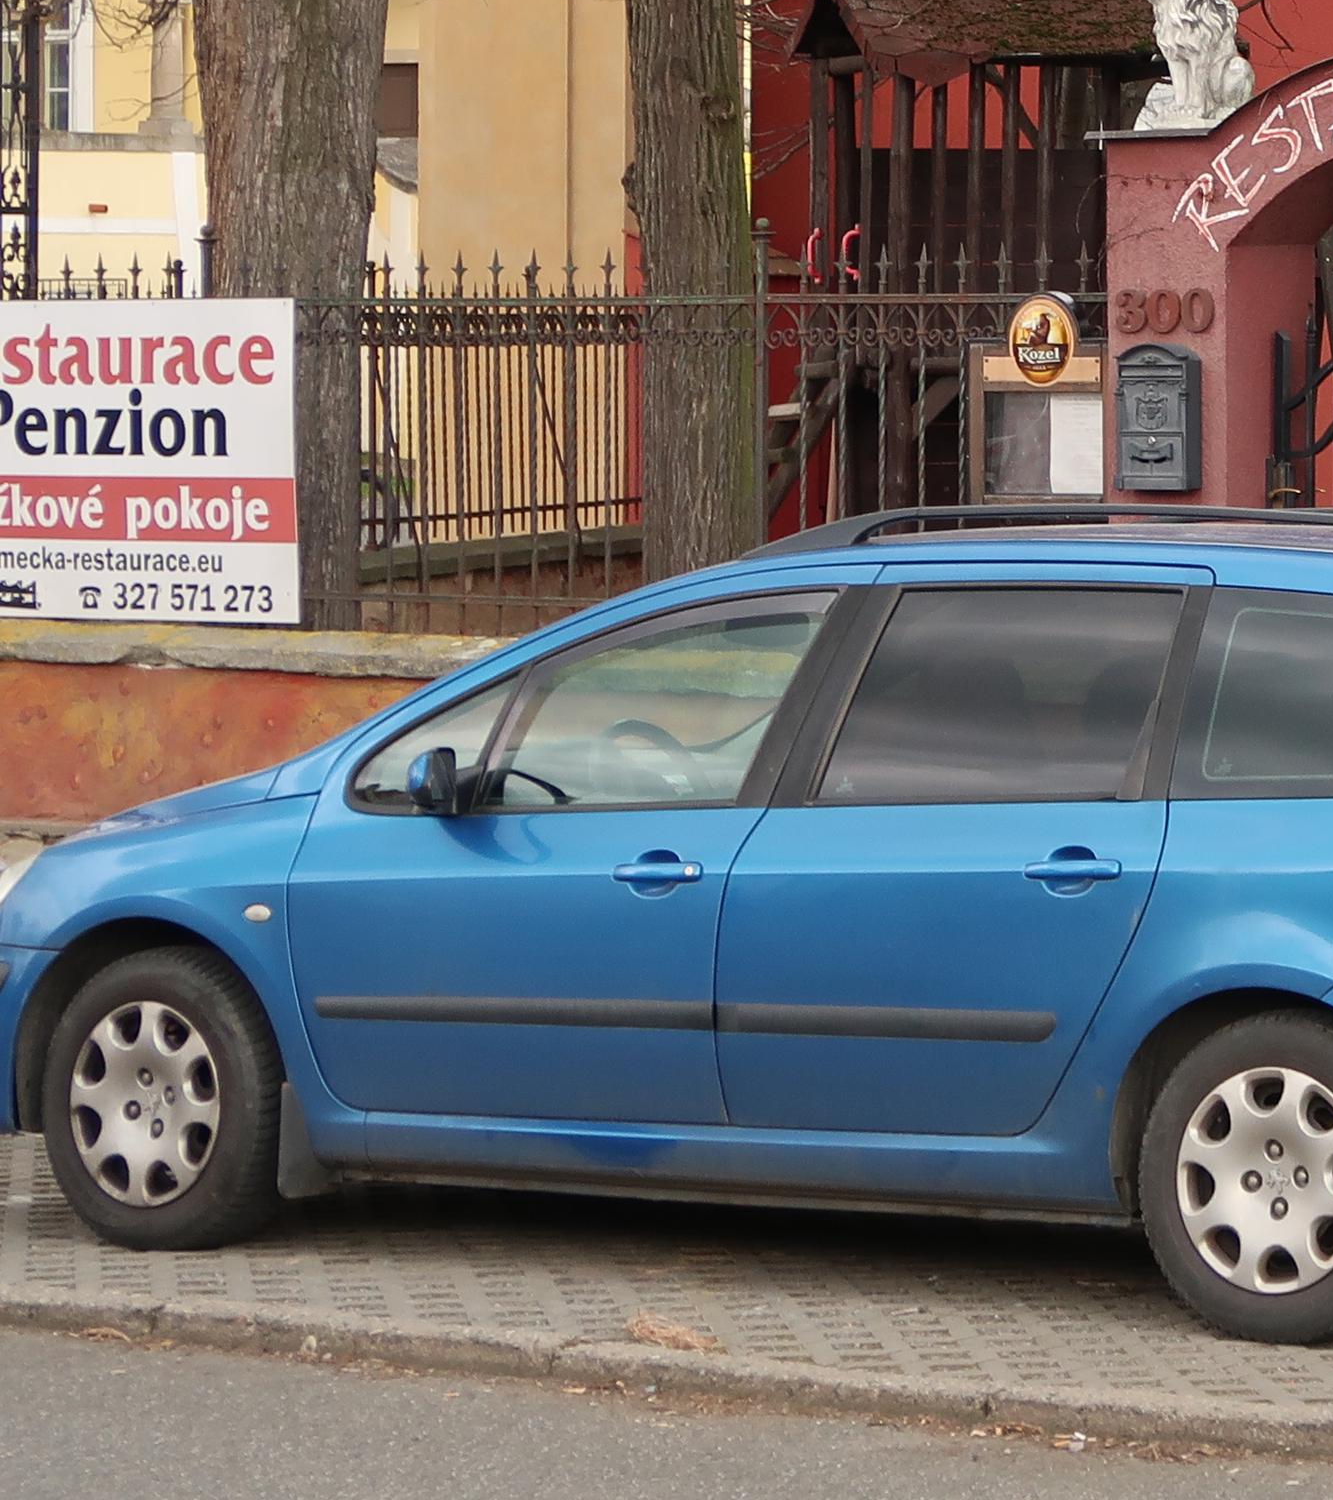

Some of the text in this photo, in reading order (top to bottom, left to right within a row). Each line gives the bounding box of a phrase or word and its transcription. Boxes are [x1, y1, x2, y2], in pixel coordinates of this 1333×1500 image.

[1116, 287, 1215, 334] 300
[1018, 347, 1060, 364] Kozel
[125, 485, 270, 540] pokoje
[113, 582, 274, 613] 327 571 273
